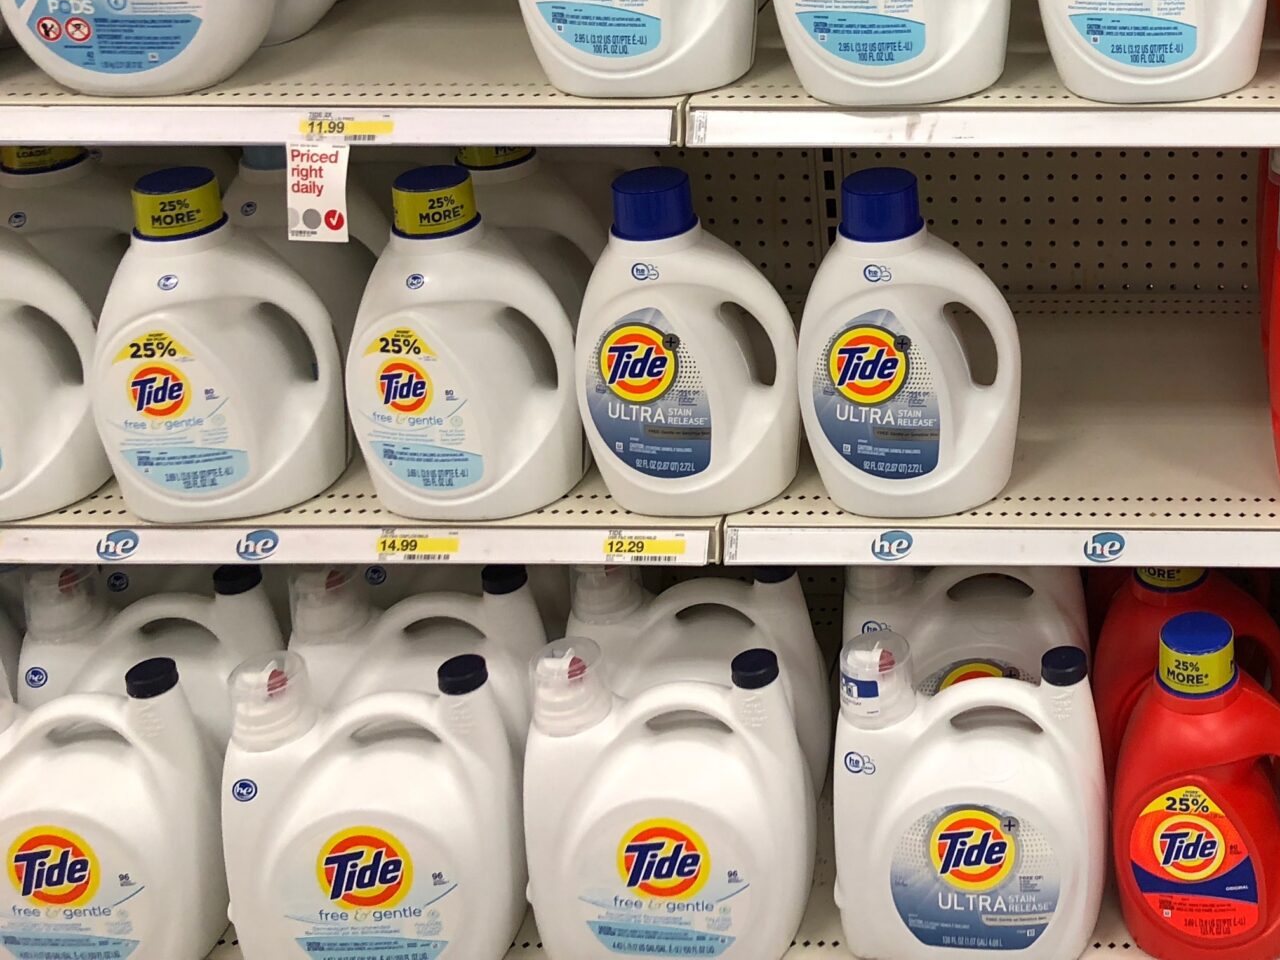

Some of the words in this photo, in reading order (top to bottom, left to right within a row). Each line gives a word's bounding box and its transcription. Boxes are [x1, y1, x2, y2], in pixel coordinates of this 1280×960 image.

[47, 0, 94, 14] PODS
[308, 121, 344, 133] 11.99
[291, 150, 339, 163] Priced
[291, 165, 323, 180] right
[291, 181, 324, 196] daily
[160, 199, 189, 212] 25%
[428, 196, 455, 210] 25%
[130, 343, 176, 358] 25%
[380, 339, 421, 355] 25%
[608, 344, 667, 385] Tide
[837, 346, 898, 386] Tide
[131, 377, 182, 411] Tide
[380, 372, 426, 405] Tide
[609, 404, 665, 424] ULTRA
[668, 408, 692, 416] STAIN
[837, 405, 894, 424] ULTRA
[99, 532, 137, 558] he
[239, 532, 276, 558] he
[380, 540, 417, 552] 14.99
[608, 541, 644, 553] 12.29
[873, 534, 911, 558] he
[1086, 535, 1123, 559] he
[1175, 659, 1199, 672] 25%
[1166, 797, 1209, 813] 25%
[938, 830, 1006, 874] Tide
[1160, 833, 1217, 866] Tide
[14, 848, 90, 896] Tide
[625, 841, 699, 887] Tide
[324, 849, 402, 899] Tide
[614, 896, 642, 908] free
[666, 899, 713, 913] gentle
[939, 893, 1005, 912] ULTRA
[1009, 895, 1036, 903] STAIN
